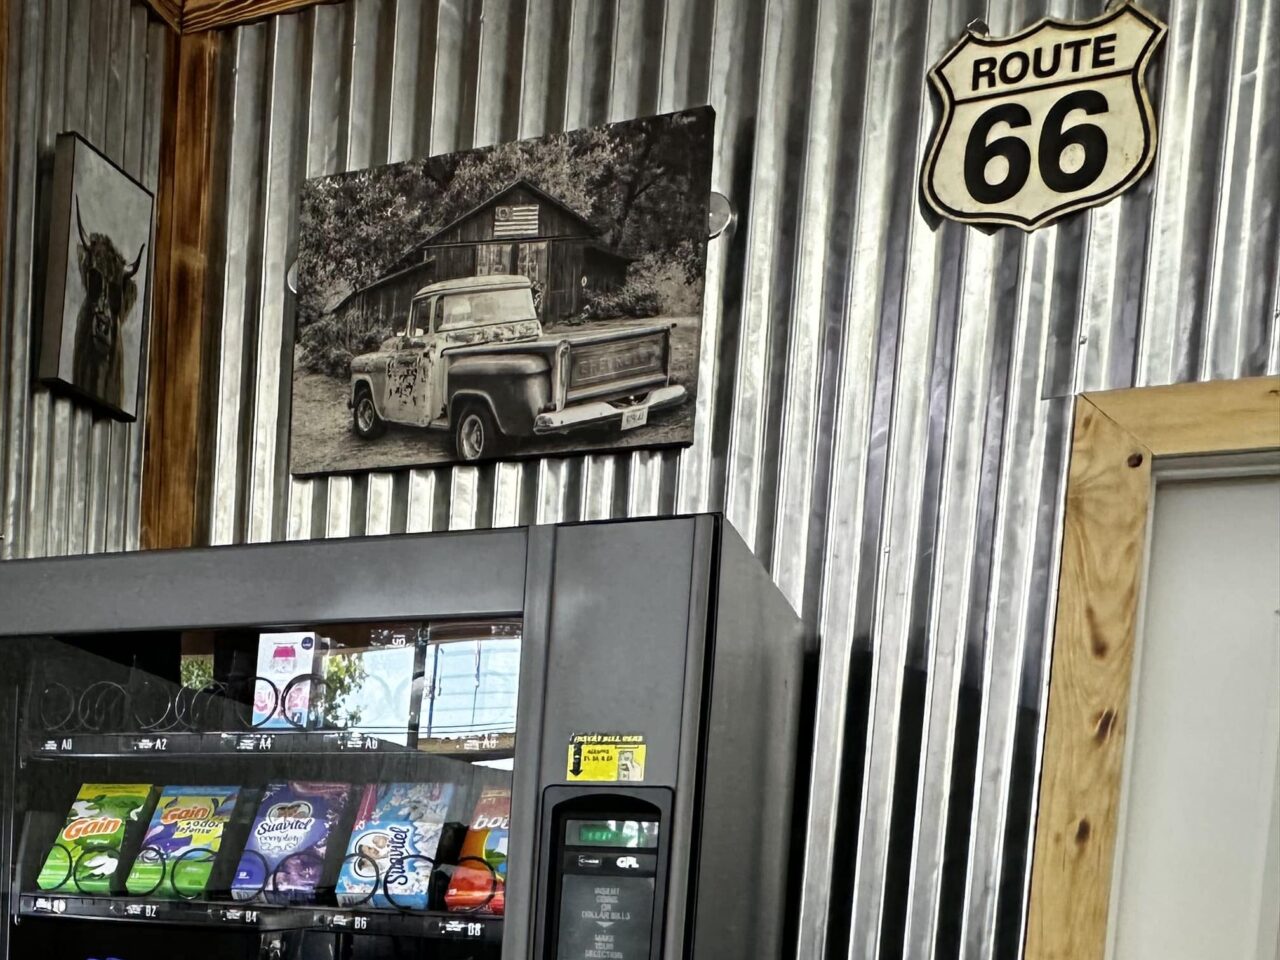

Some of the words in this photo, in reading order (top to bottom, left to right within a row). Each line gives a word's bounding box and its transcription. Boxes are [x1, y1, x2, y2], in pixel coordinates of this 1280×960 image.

[971, 33, 1117, 91] ROUTE
[963, 89, 1109, 205] 66
[155, 738, 167, 750] A2
[259, 737, 272, 750] A4
[160, 806, 211, 824] Gain
[63, 817, 122, 841] Gain
[257, 818, 311, 836] Suavitel
[386, 826, 410, 886] Suavitel
[354, 917, 367, 929] B6
